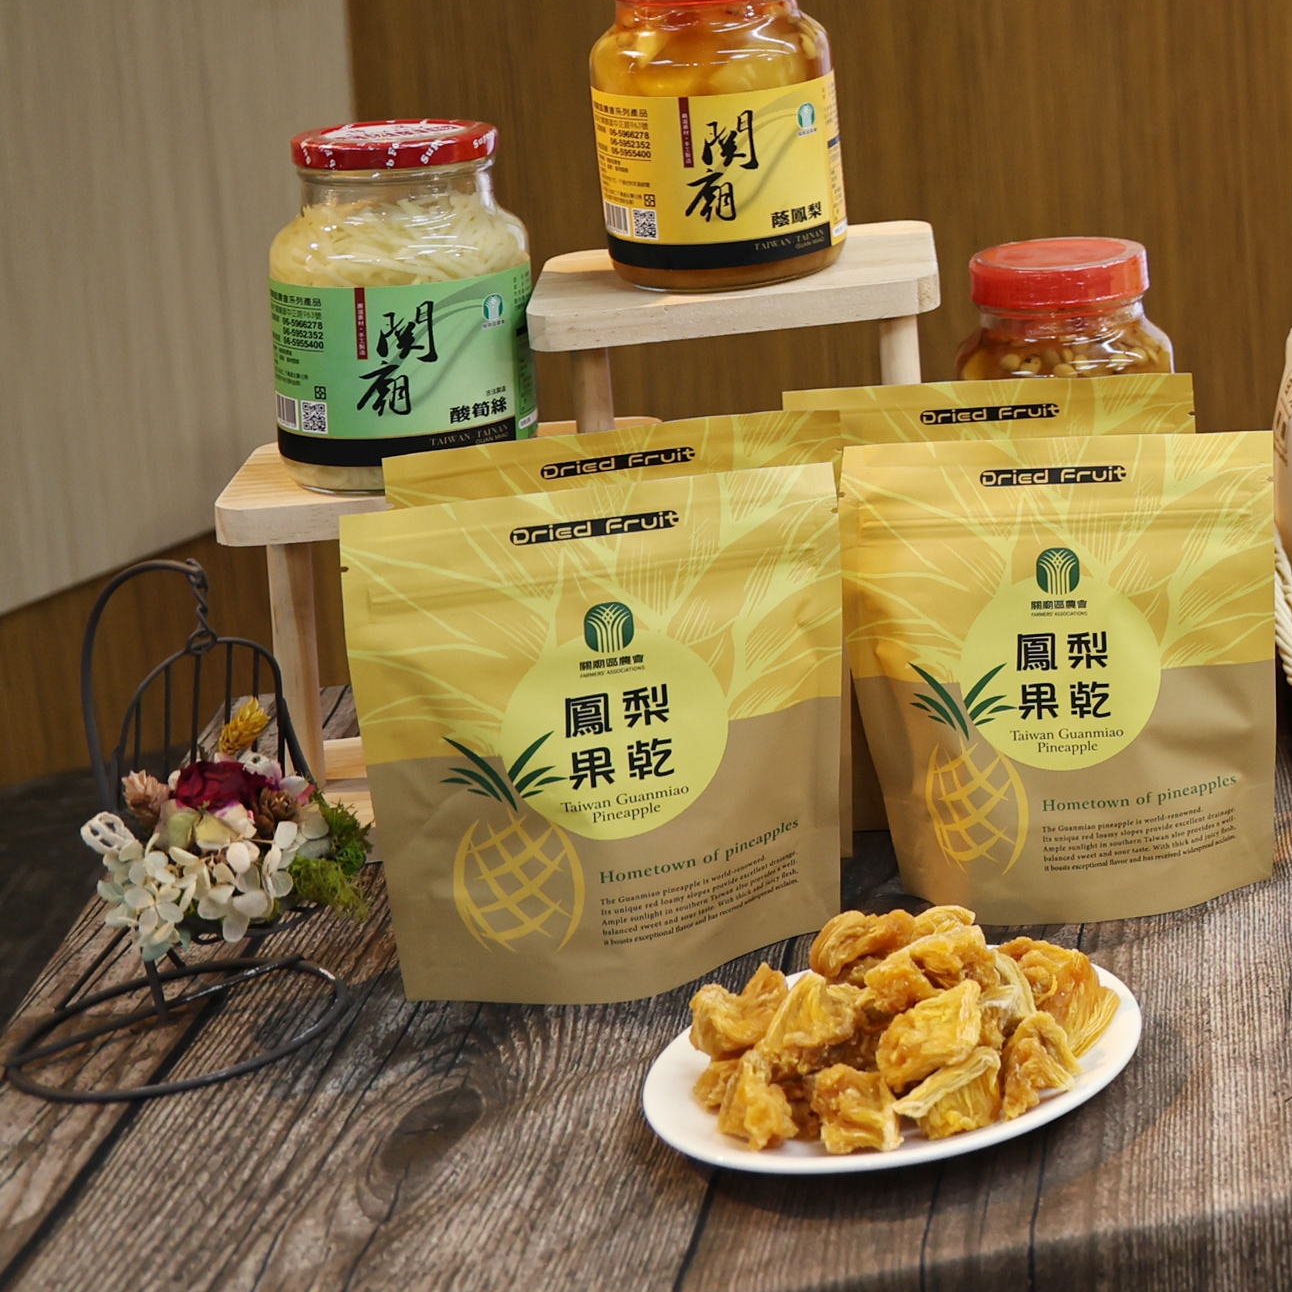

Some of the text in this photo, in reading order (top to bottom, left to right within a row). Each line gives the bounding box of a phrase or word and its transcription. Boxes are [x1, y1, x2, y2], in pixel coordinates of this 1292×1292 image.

[770, 201, 822, 229] 蔭鳳梨
[449, 396, 507, 424] 酸筍絲
[922, 403, 1060, 424] Dried Fruit
[430, 433, 470, 446] TAIWAN
[542, 447, 695, 480] Dried Fruit
[981, 466, 1127, 486] Dried Fruit
[512, 510, 679, 545] Dried Fruit
[1016, 631, 1108, 672] 鳳梨
[564, 683, 669, 739] 鳳梨
[1018, 681, 1111, 721] 果乾
[1009, 727, 1124, 741] Taiwan Guanmiao
[1037, 741, 1098, 755] Pineapple
[569, 738, 675, 790] 果乾
[560, 785, 689, 814] Taiwan Guanmiao
[1042, 774, 1237, 812] Hometown of pineapples
[592, 802, 661, 824] Pineapple
[1042, 825, 1056, 833] The
[1057, 823, 1096, 832] Guanmiao
[1097, 819, 1134, 831] pineapple
[1144, 806, 1204, 824] world-renowned.
[1043, 845, 1066, 853] Ample
[1068, 843, 1098, 851] sunlight
[1109, 838, 1142, 847] southern
[1144, 834, 1170, 843] Taiwan
[1171, 830, 1185, 838] also
[1186, 823, 1215, 837] provides
[1054, 835, 1079, 843] unique
[1081, 832, 1094, 840] red
[1145, 823, 1173, 834] provide
[1174, 815, 1206, 828] excellent
[599, 819, 799, 884] Hometown of pineapples
[1043, 854, 1075, 862] balanced
[1152, 843, 1170, 851] With
[1190, 835, 1203, 843] and
